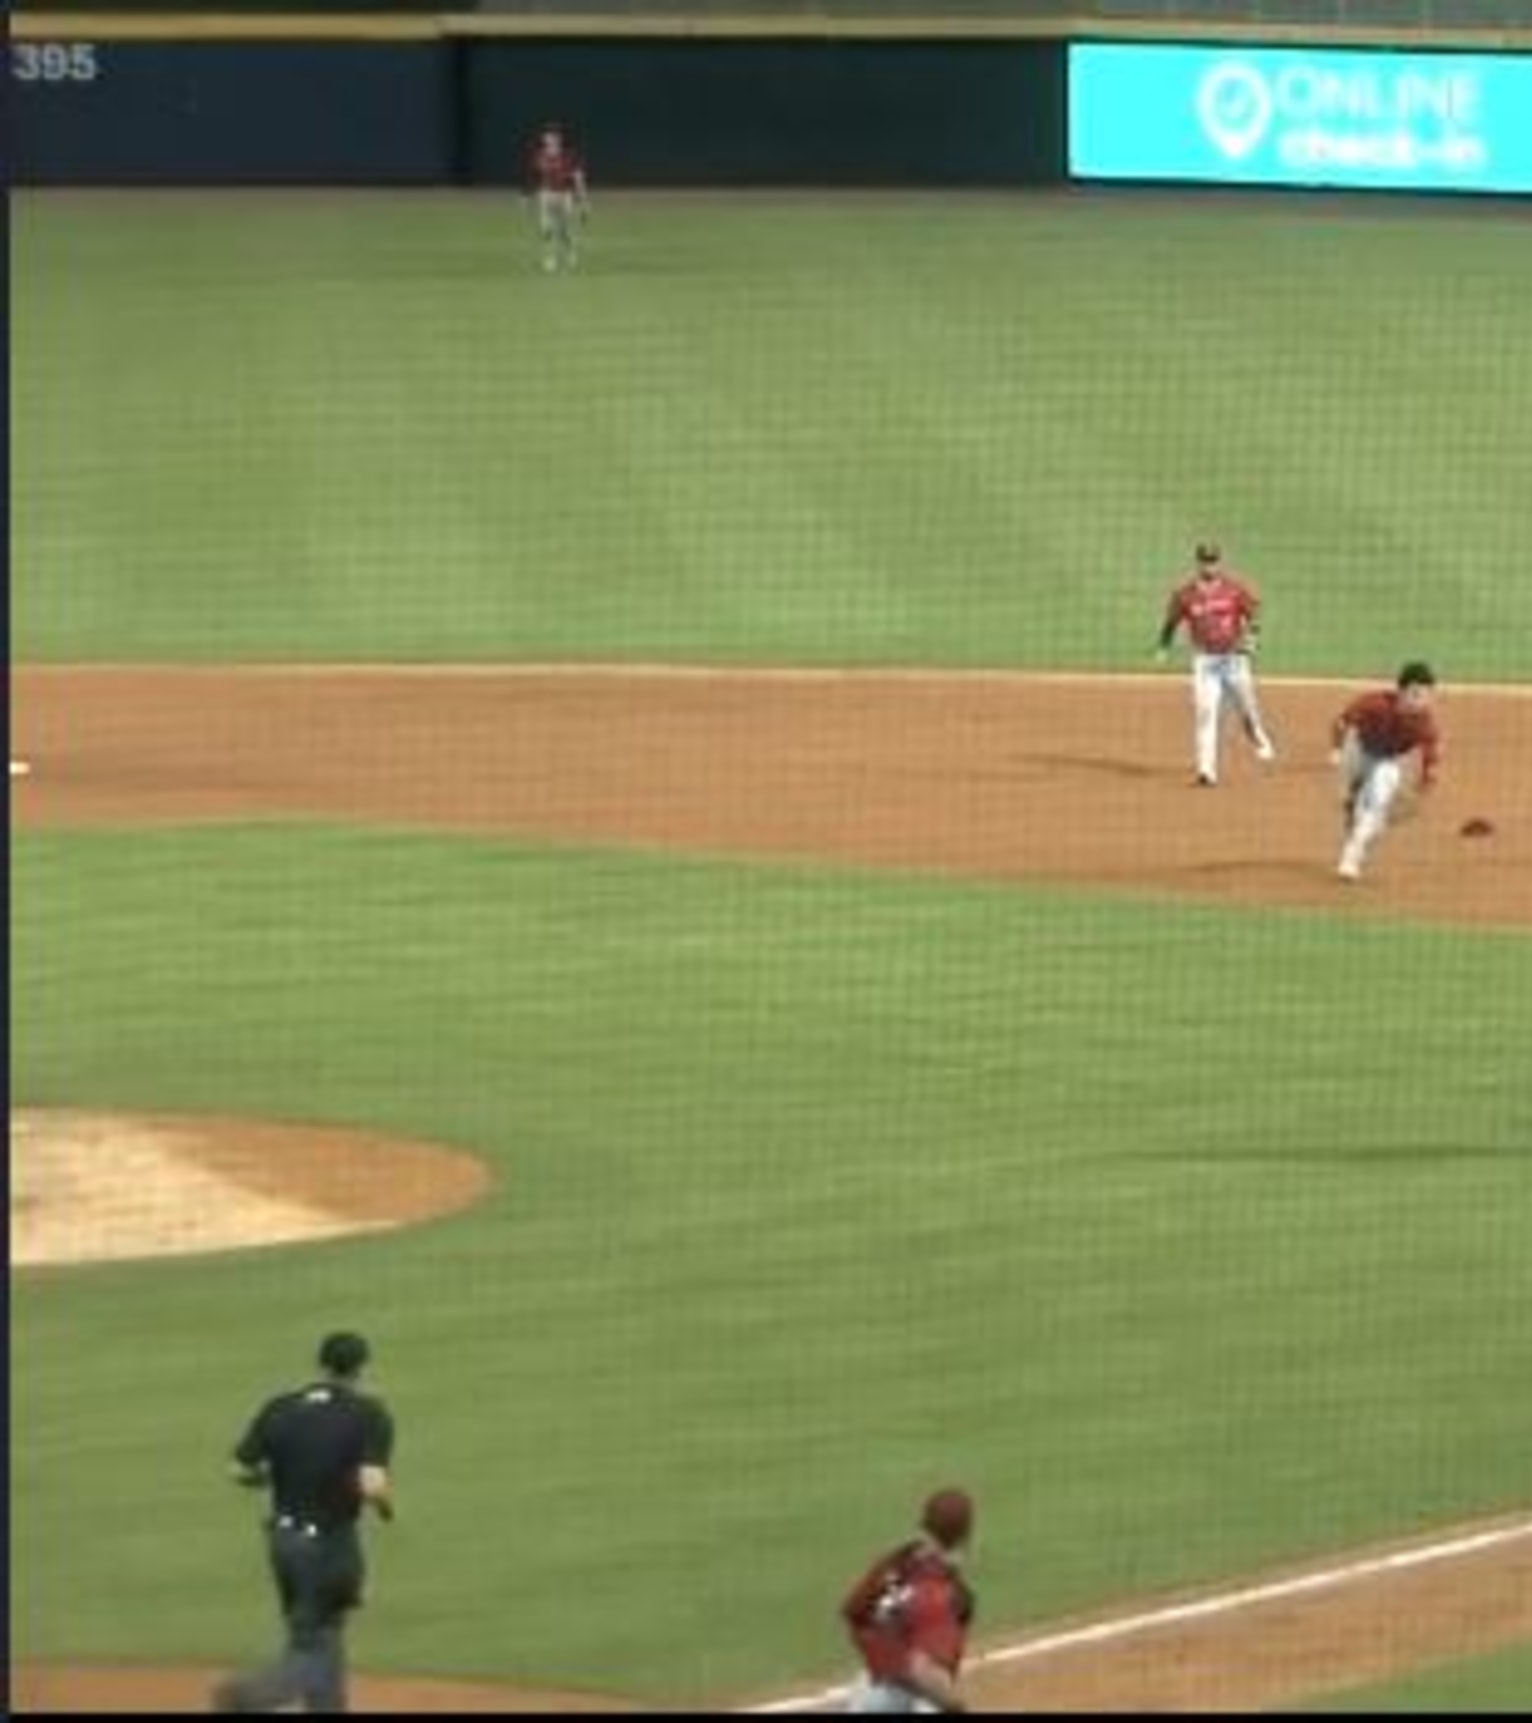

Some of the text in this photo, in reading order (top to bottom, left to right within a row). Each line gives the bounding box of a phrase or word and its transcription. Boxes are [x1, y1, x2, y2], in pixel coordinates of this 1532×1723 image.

[12, 43, 97, 81] 395
[1277, 65, 1480, 121] ONLINE
[1278, 126, 1486, 170] check-in
